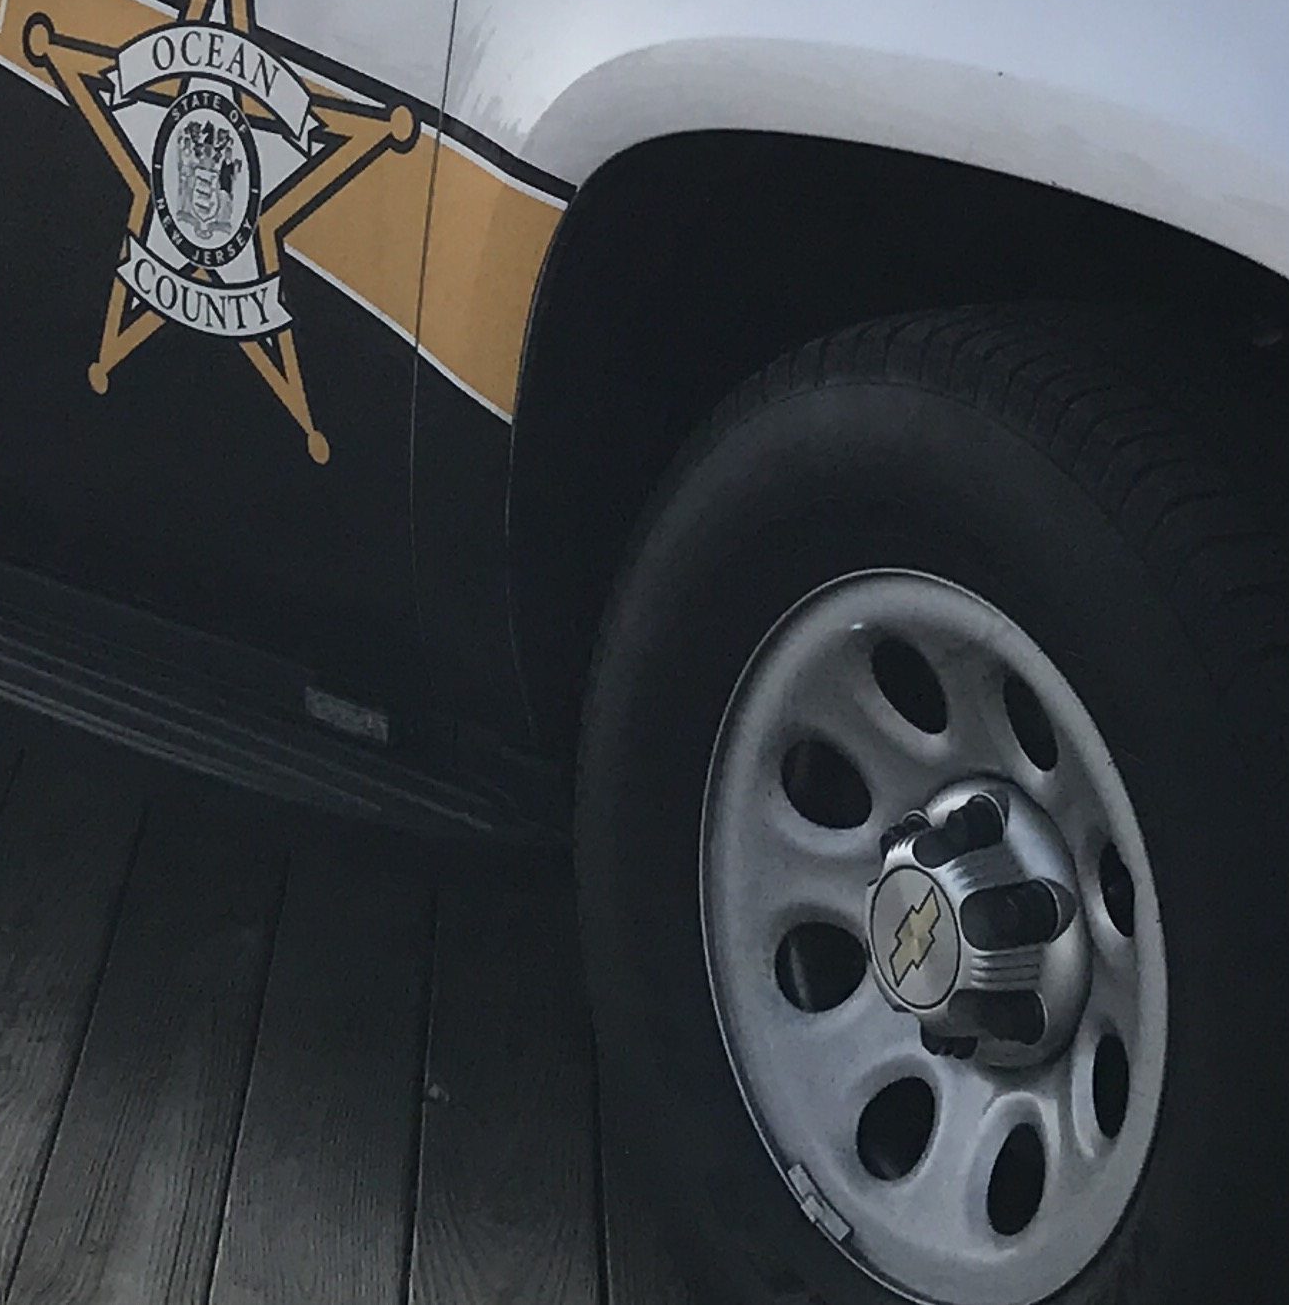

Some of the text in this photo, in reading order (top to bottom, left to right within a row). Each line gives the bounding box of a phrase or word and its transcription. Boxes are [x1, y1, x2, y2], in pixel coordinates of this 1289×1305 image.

[152, 31, 281, 99] OCEAN
[172, 93, 248, 135] STATE OF
[156, 198, 253, 266] NEW JERSEY
[133, 257, 272, 331] COUNTY
